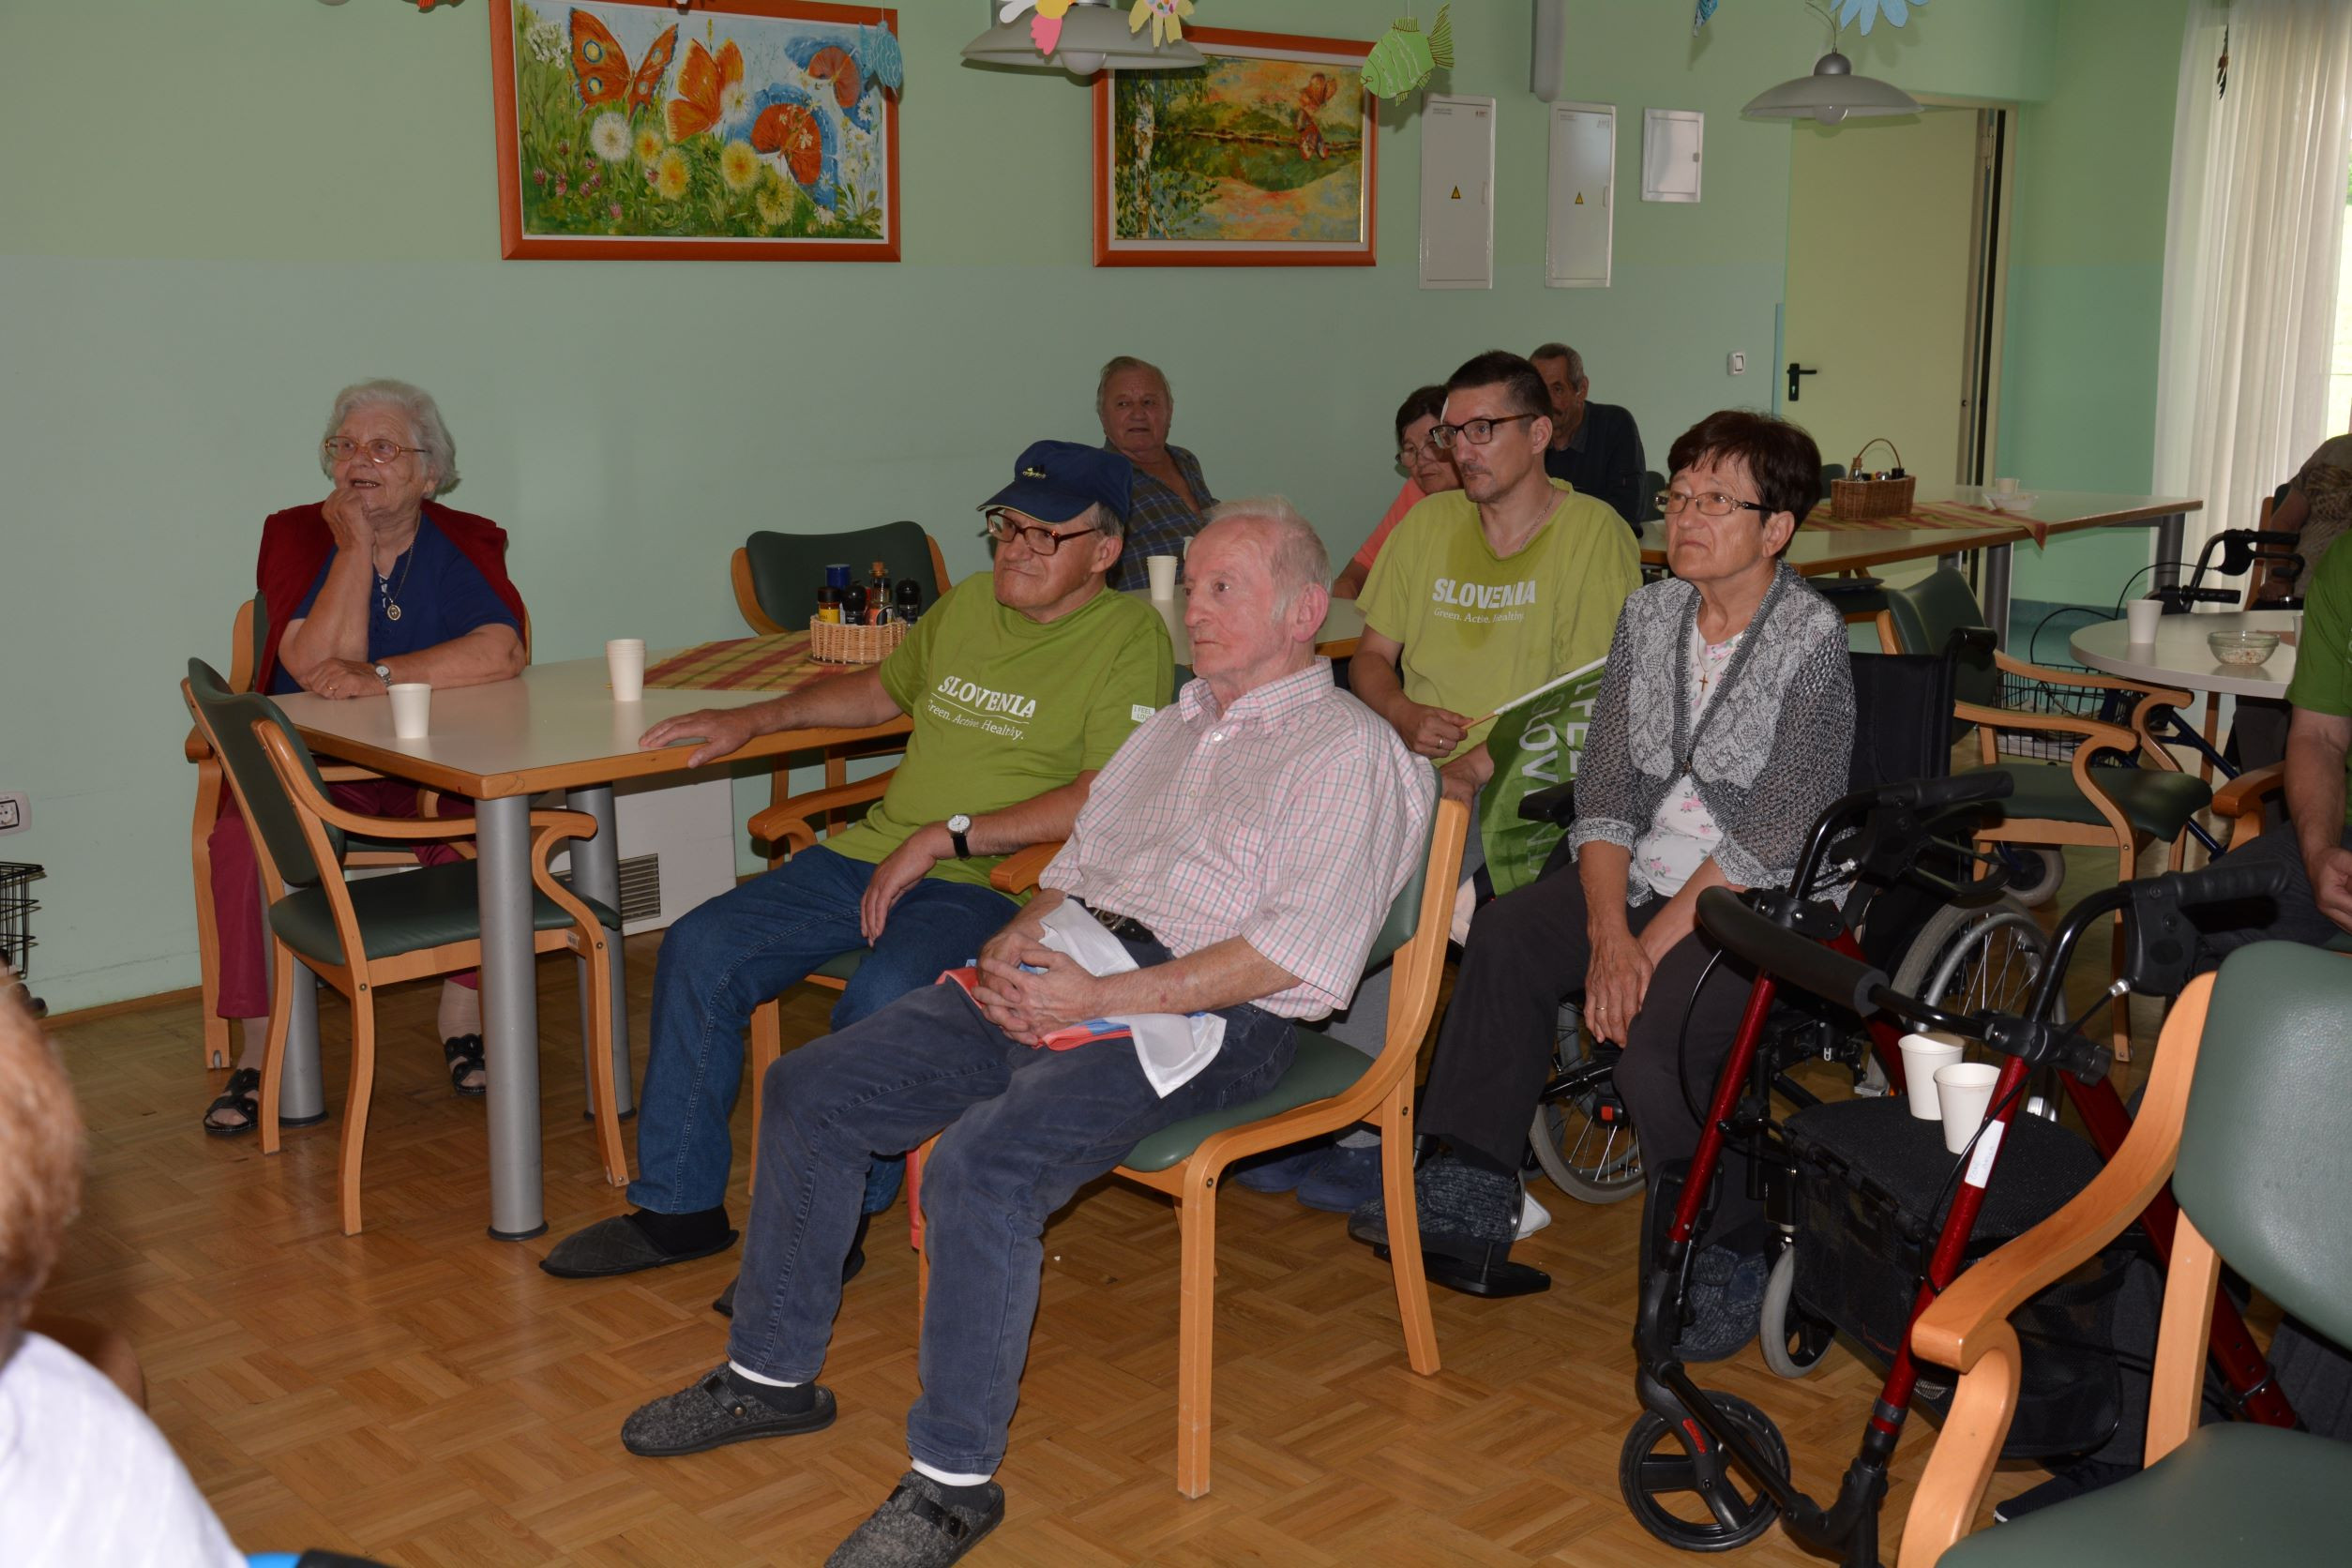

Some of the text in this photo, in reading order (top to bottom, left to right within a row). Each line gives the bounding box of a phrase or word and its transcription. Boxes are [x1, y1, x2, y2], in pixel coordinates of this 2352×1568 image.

[1432, 578, 1536, 610] SLOVENIA
[1434, 608, 1462, 621] Green.
[938, 675, 1036, 718] SLOVENIA
[981, 719, 1024, 741] Healthy.
